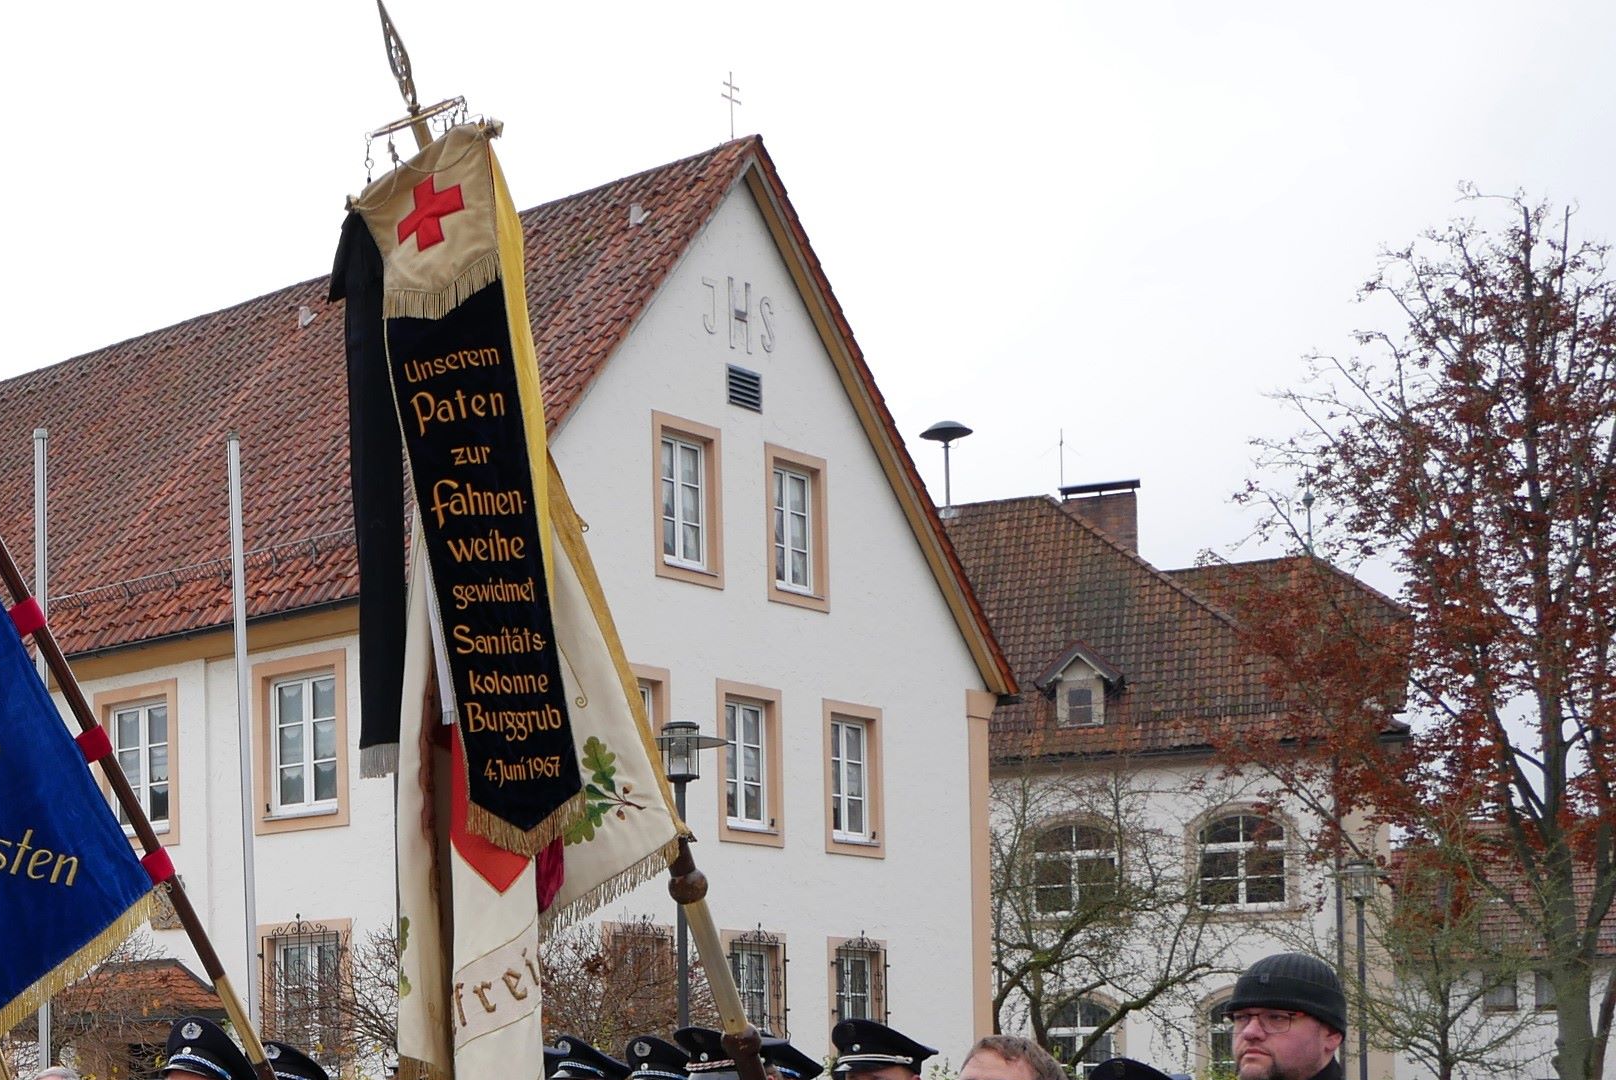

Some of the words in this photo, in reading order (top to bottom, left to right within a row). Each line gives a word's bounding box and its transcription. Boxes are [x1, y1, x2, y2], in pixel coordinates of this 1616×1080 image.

[404, 347, 500, 383] Unserem
[410, 389, 505, 437] Paten
[450, 445, 491, 466] zur
[446, 528, 526, 563] weihe
[452, 576, 535, 610] gewidmet
[453, 624, 546, 655] Sanitäts-
[464, 701, 562, 742] Burggrub
